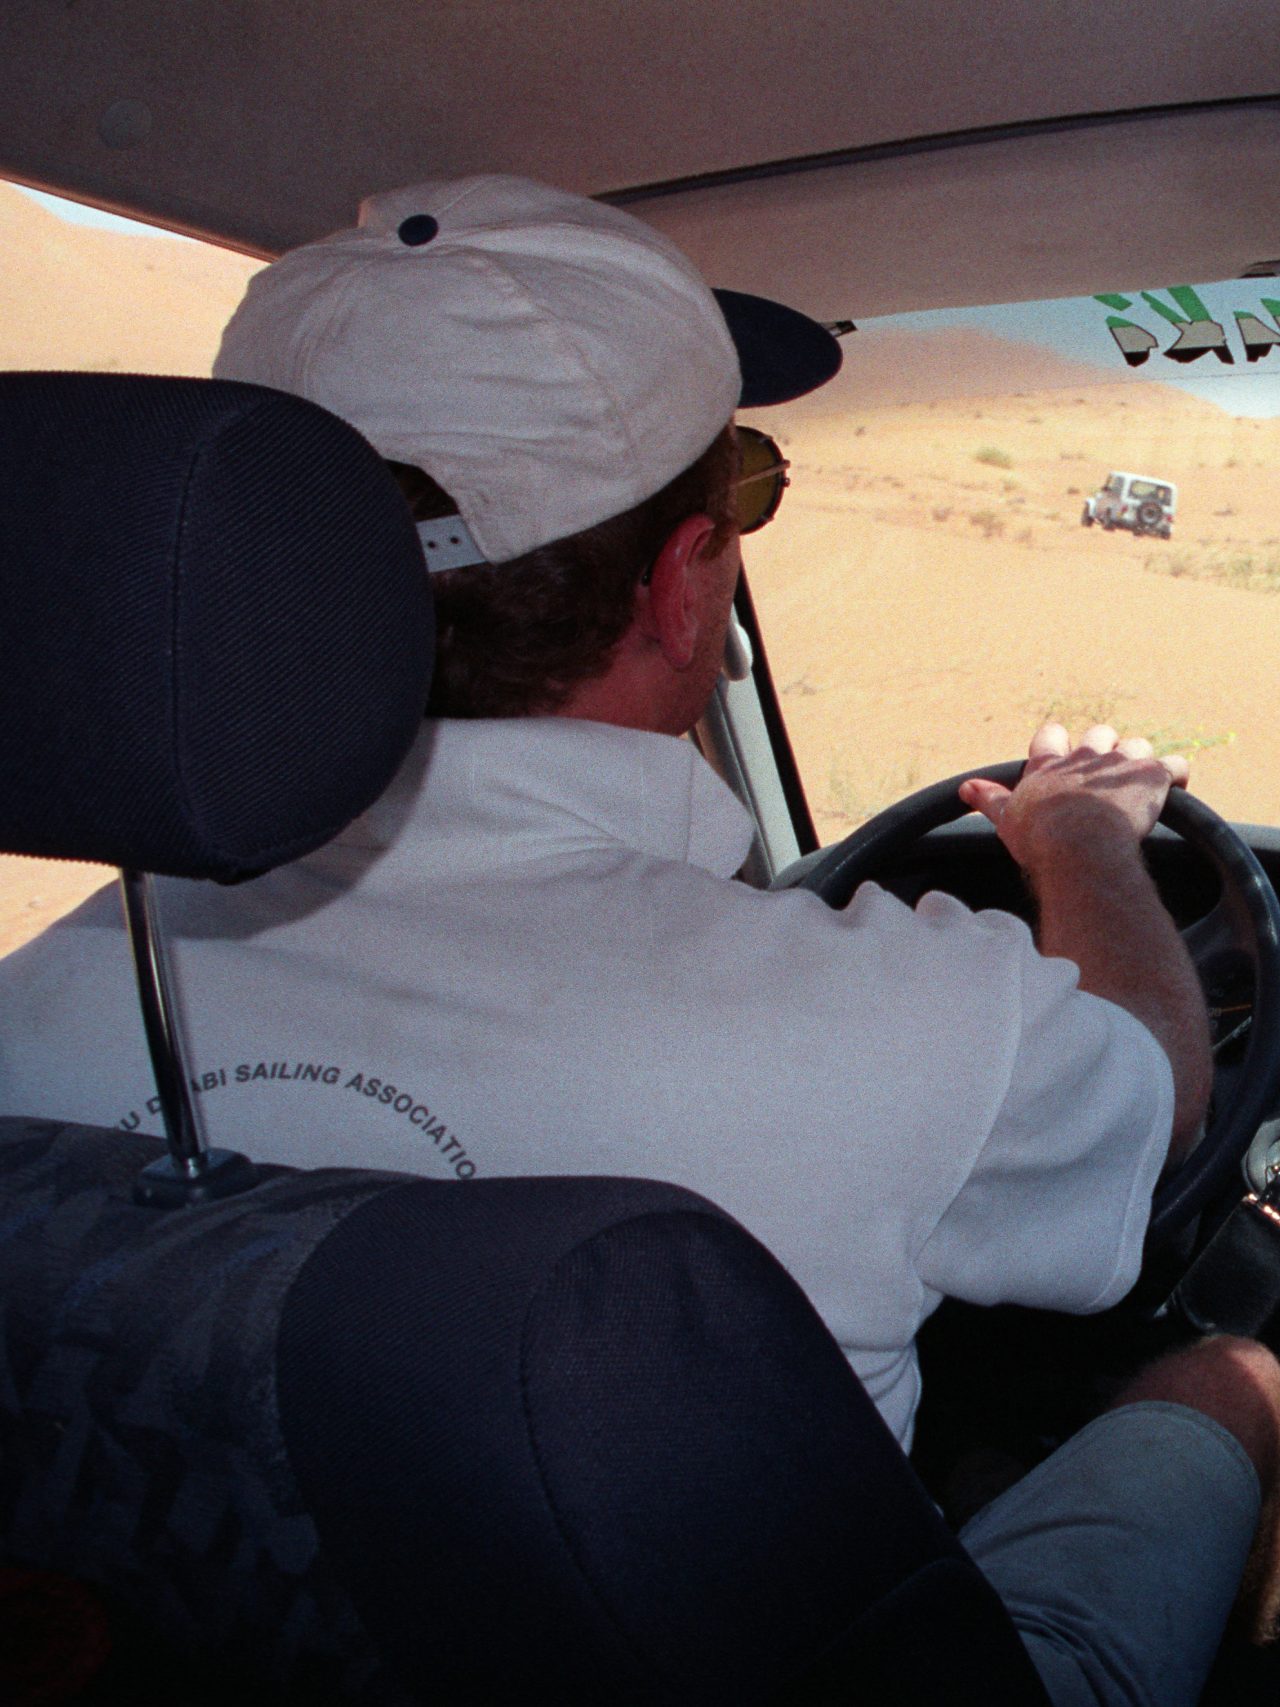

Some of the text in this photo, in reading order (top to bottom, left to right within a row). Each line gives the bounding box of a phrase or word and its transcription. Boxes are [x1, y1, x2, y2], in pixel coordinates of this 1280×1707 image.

[145, 1068, 227, 1115] DABI
[235, 1061, 341, 1085] SAILING
[344, 1071, 478, 1181] ASSOCIATIO
